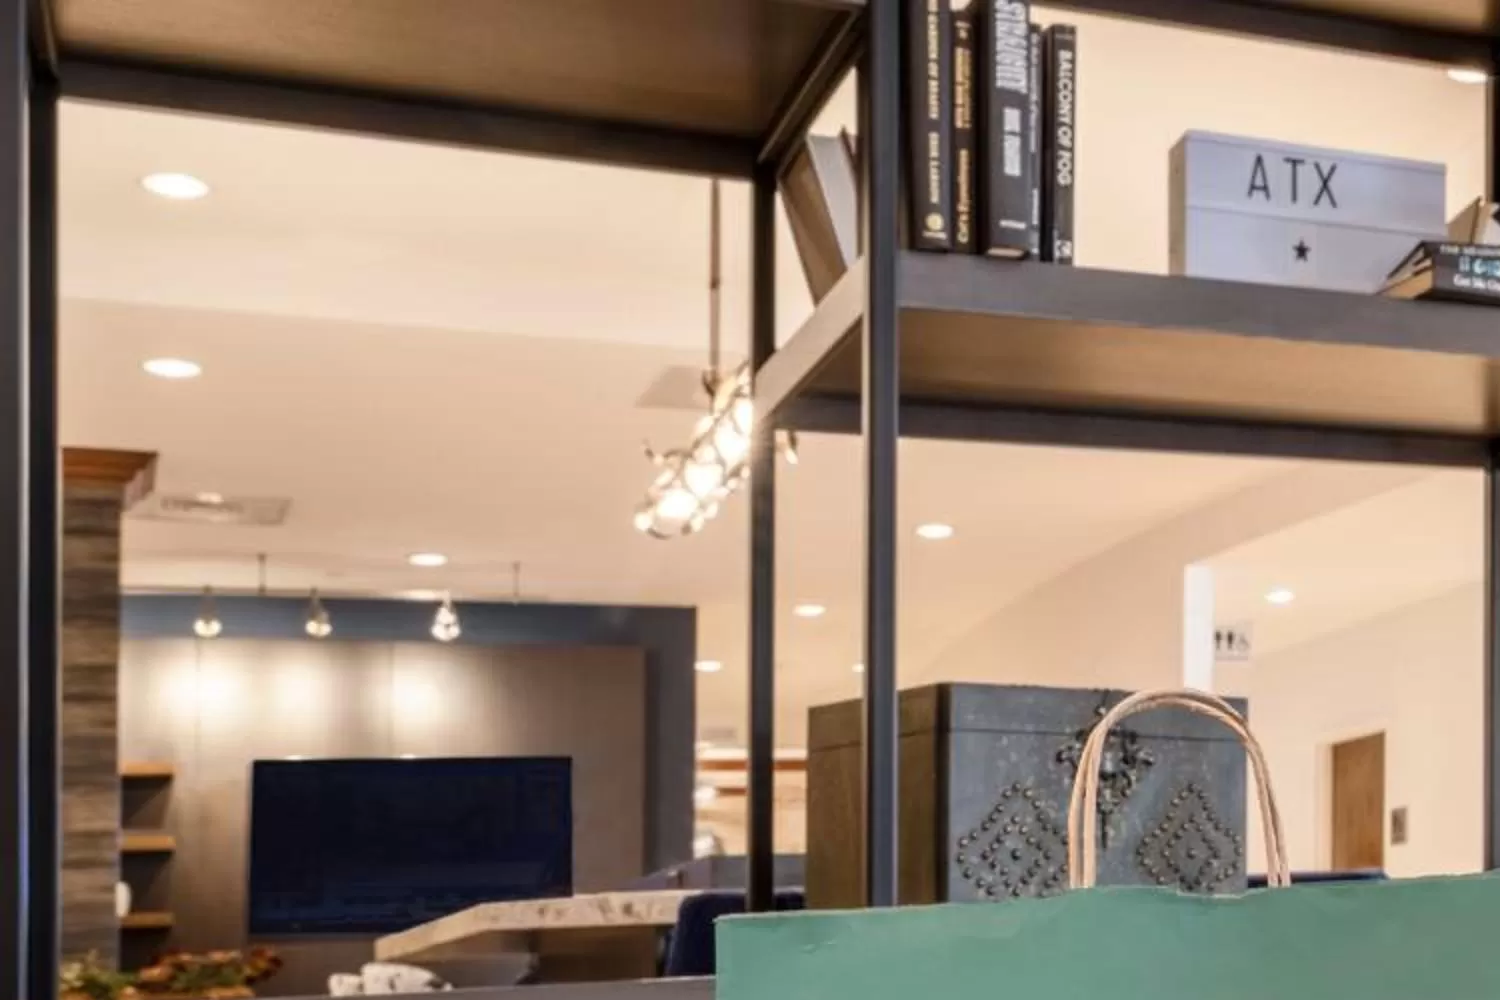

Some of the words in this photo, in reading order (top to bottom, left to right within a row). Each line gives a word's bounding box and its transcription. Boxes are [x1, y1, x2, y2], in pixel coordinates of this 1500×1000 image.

[1057, 49, 1073, 125] BALCONY
[1057, 151, 1073, 186] FOG
[1246, 153, 1338, 208] ATX
